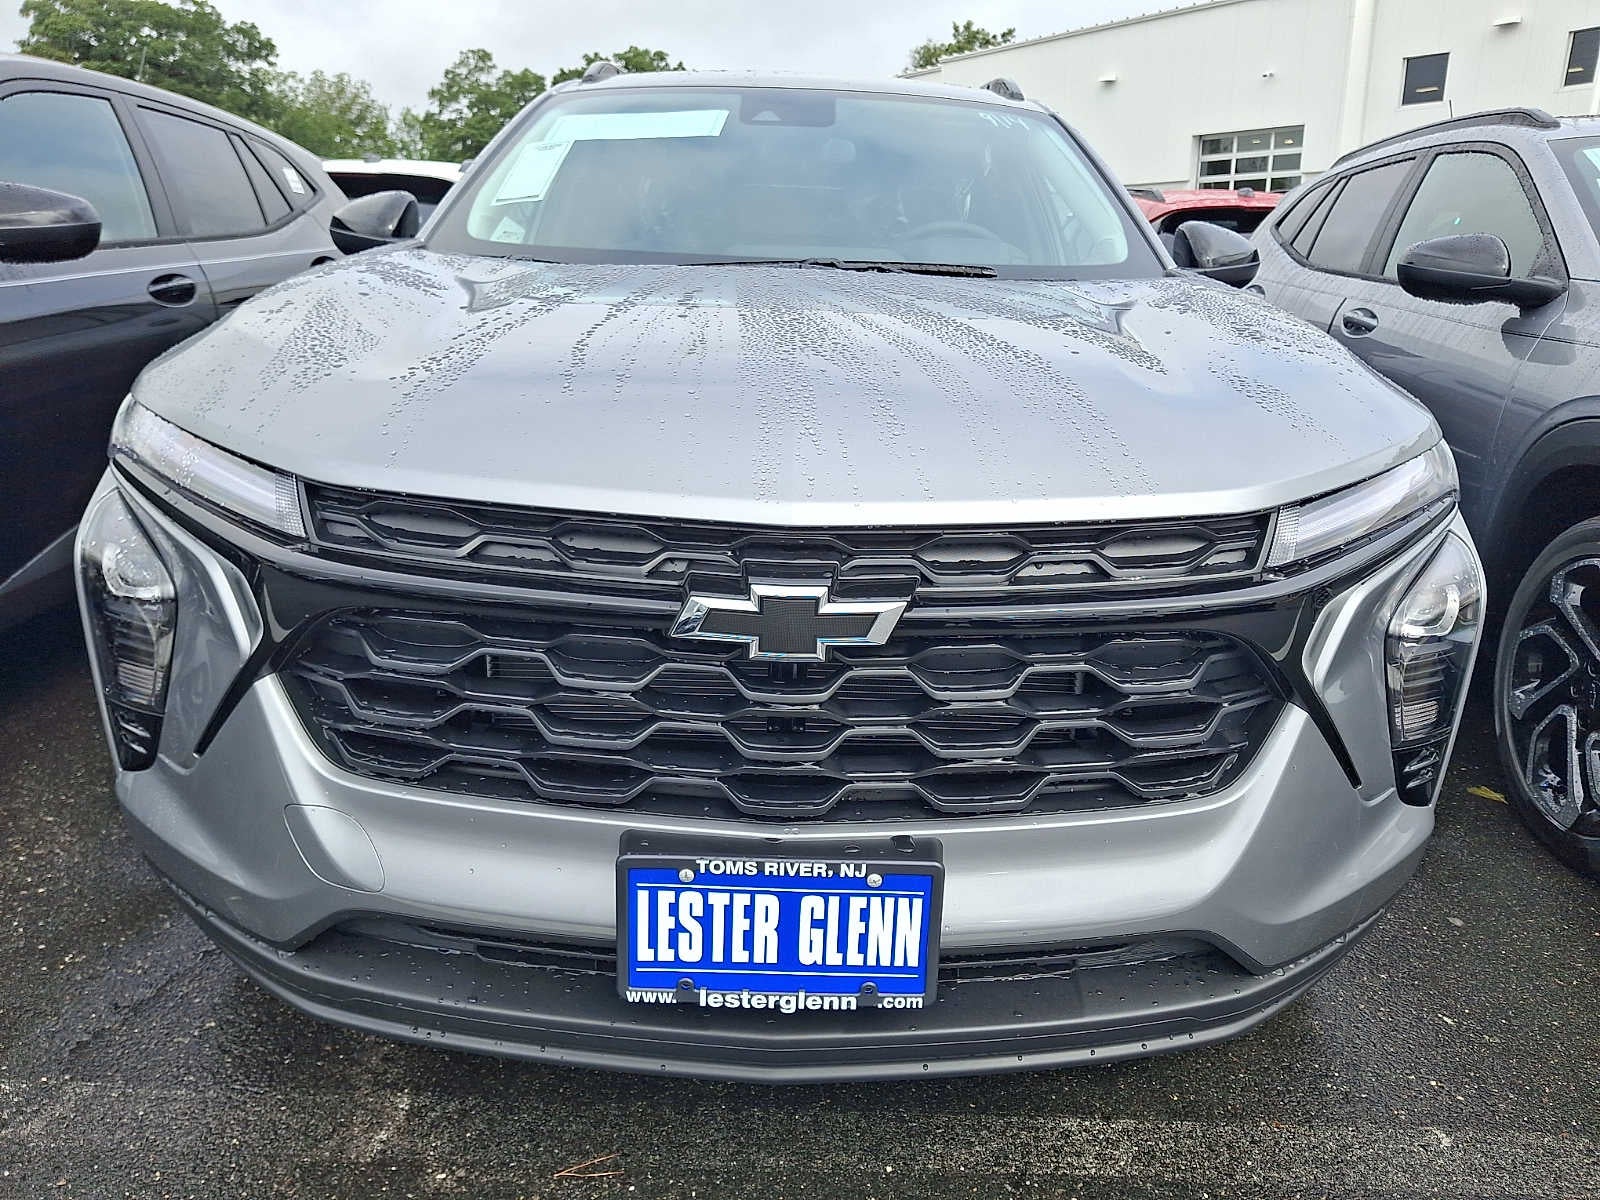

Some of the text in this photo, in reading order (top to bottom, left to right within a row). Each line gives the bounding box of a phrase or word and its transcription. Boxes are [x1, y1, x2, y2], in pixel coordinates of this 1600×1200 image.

[696, 859, 867, 878] TOMS RIVER, NJ
[637, 889, 923, 967] LESTER GLENN
[625, 987, 923, 1014] www. lesterglenn .com
